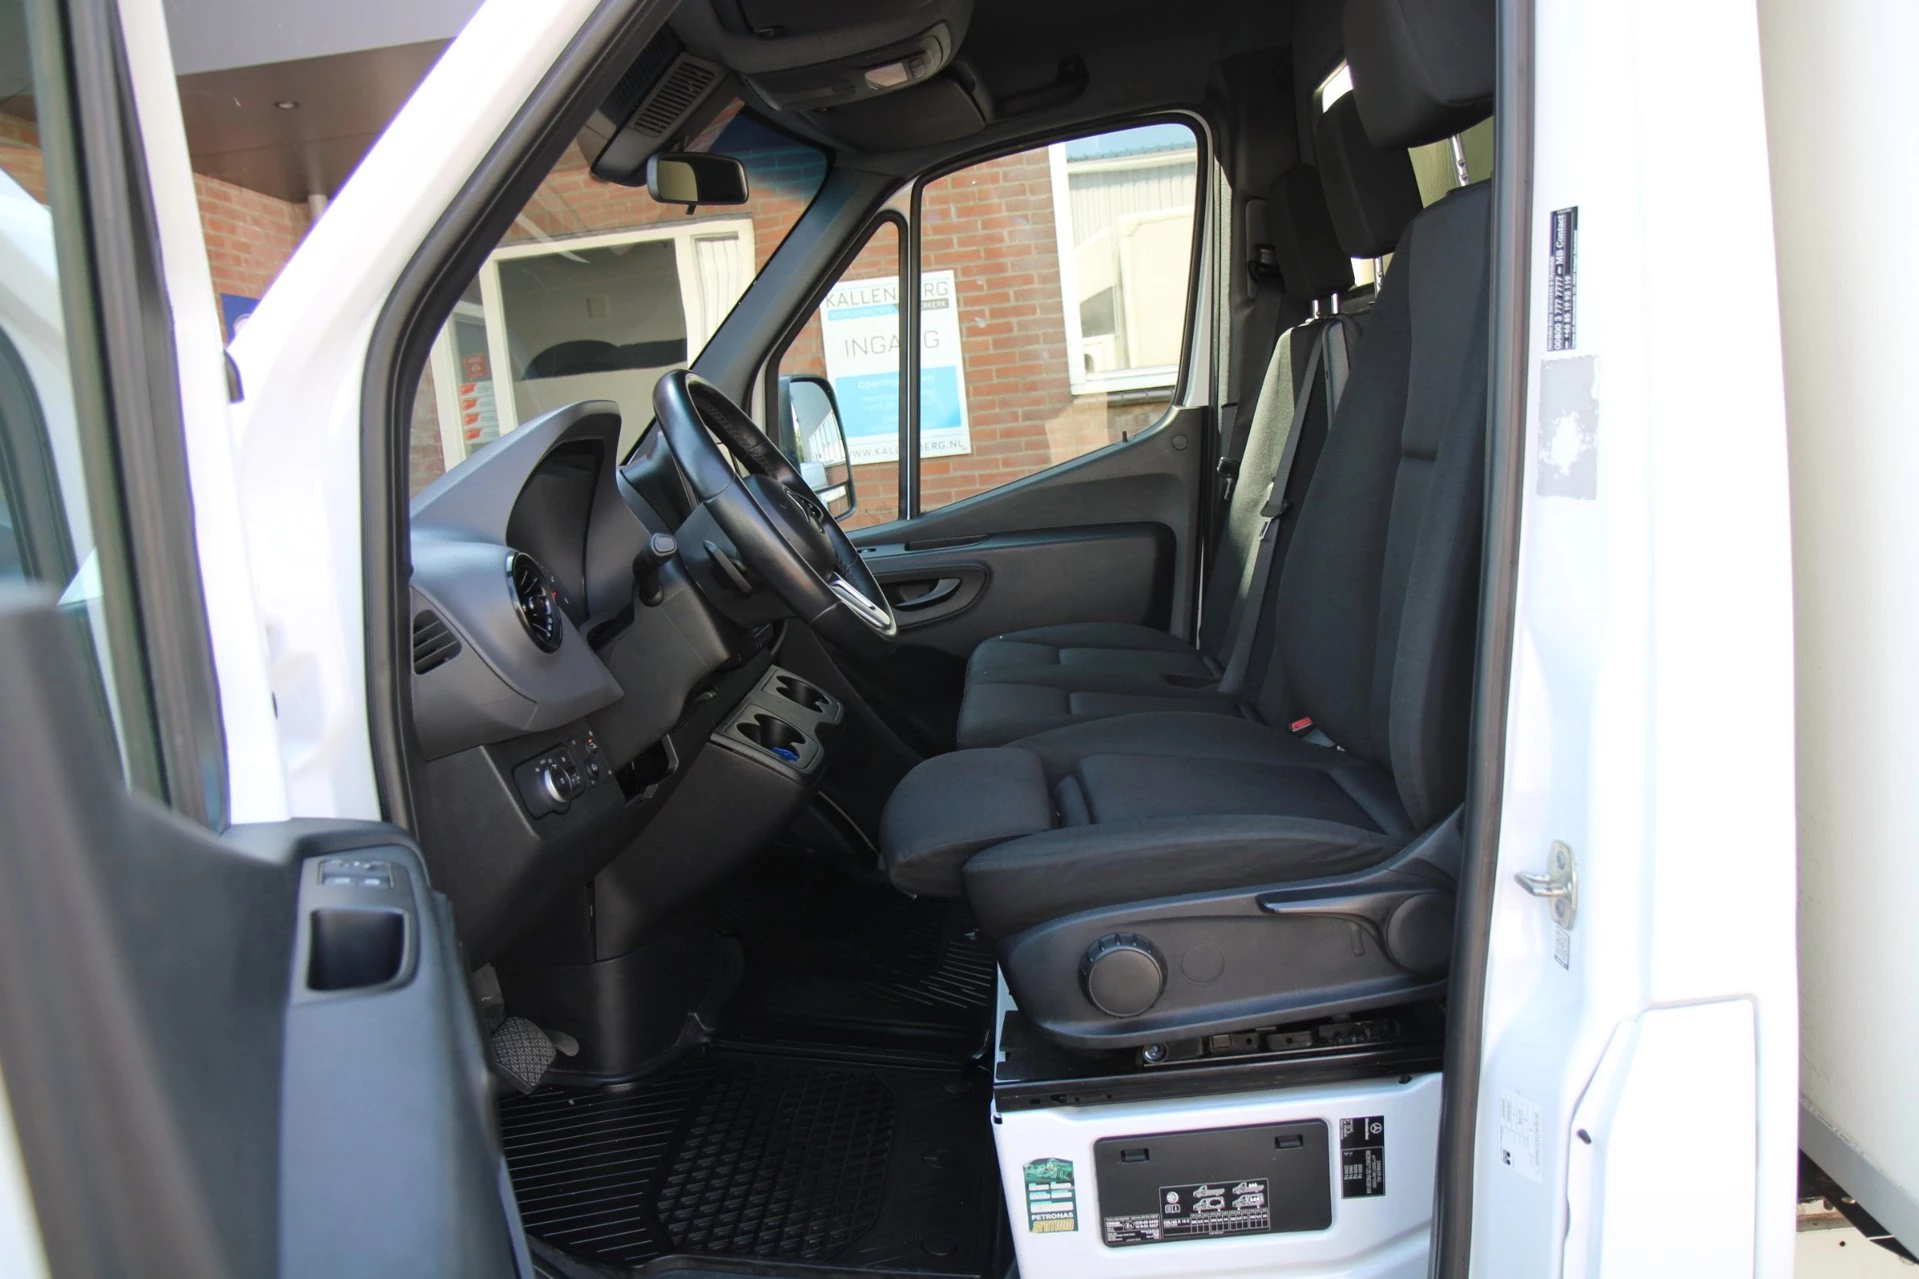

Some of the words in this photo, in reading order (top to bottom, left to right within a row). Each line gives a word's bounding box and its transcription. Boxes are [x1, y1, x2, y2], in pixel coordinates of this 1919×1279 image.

[1556, 214, 1564, 249] Contact
[825, 281, 949, 308] KALLENRG
[1555, 276, 1563, 297] 7777
[1554, 298, 1562, 314] 777
[845, 330, 940, 357] INGAG
[1032, 1212, 1074, 1221] PETRONAS
